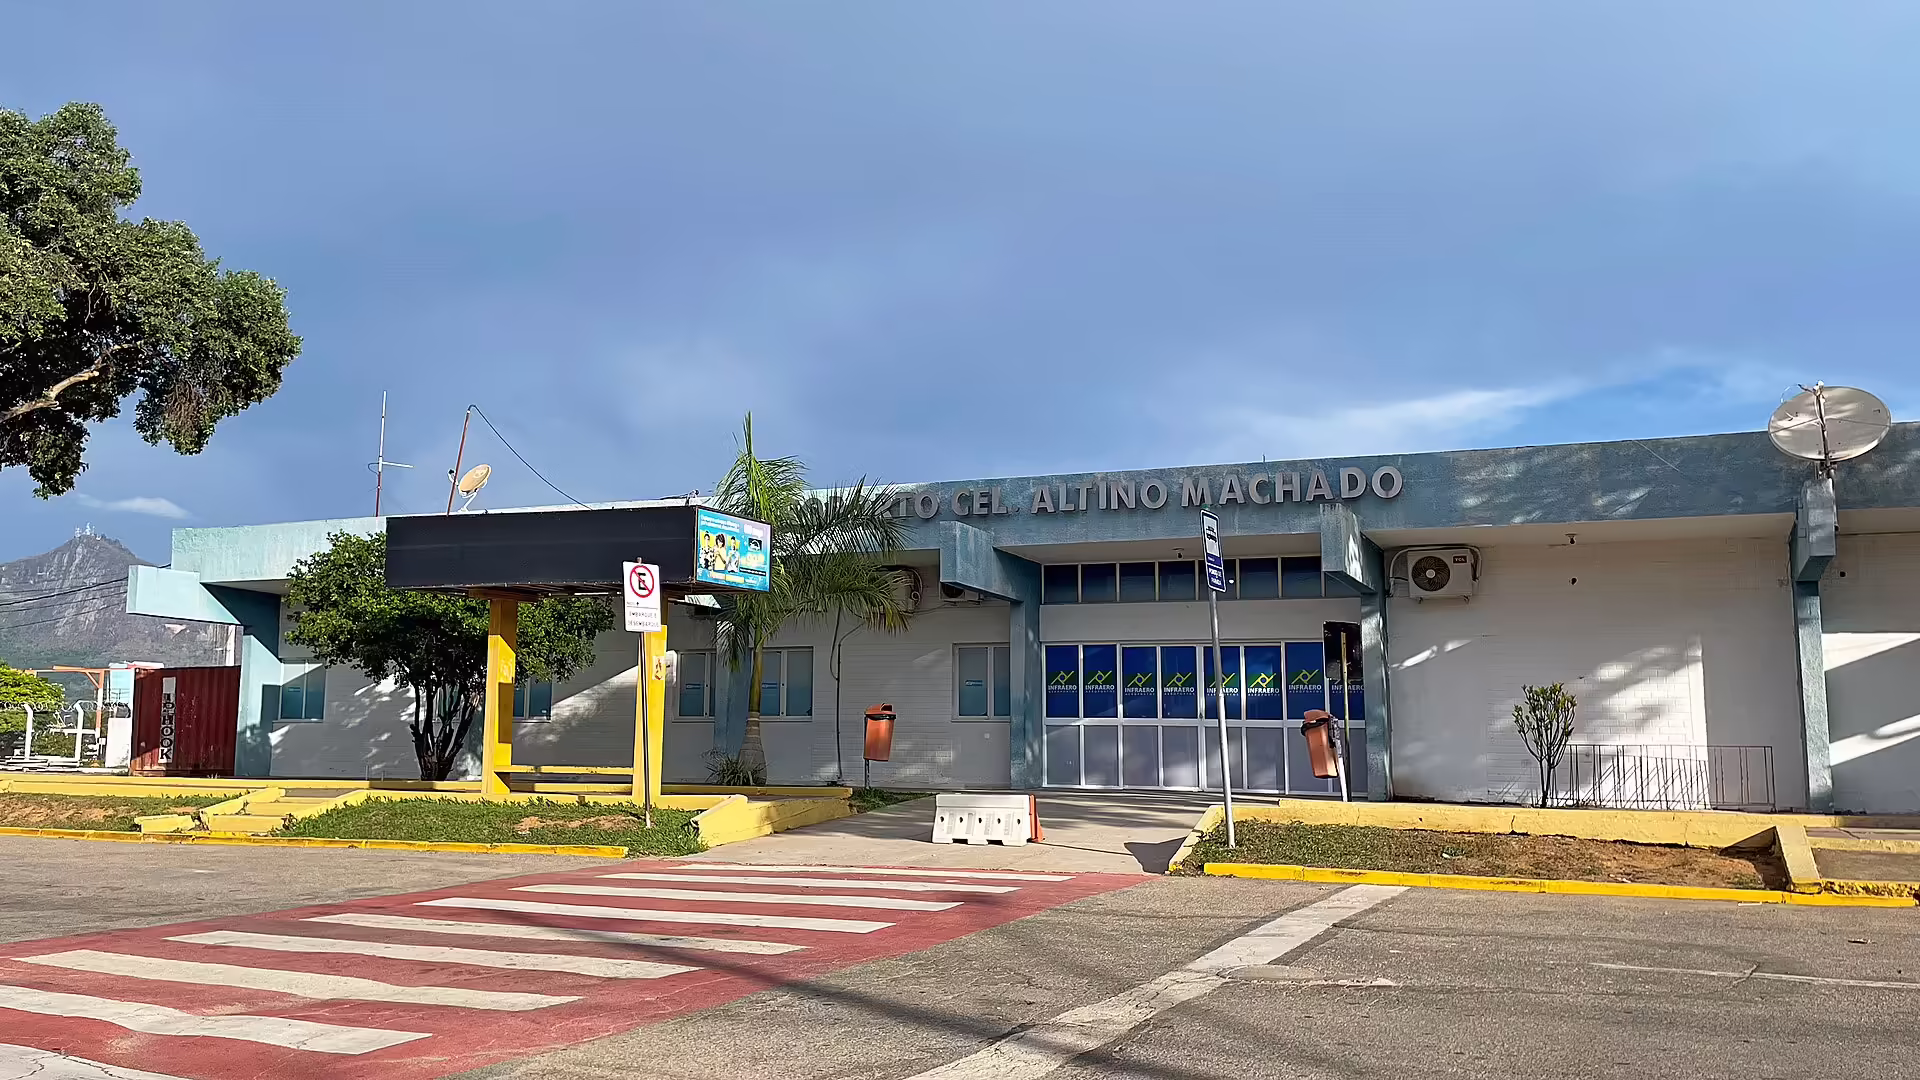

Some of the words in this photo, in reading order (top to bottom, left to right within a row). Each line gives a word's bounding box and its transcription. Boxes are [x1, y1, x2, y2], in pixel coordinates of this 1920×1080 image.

[951, 486, 1020, 516] CEL.
[1031, 477, 1168, 514] ALTINO
[1181, 465, 1403, 507] MACHADO
